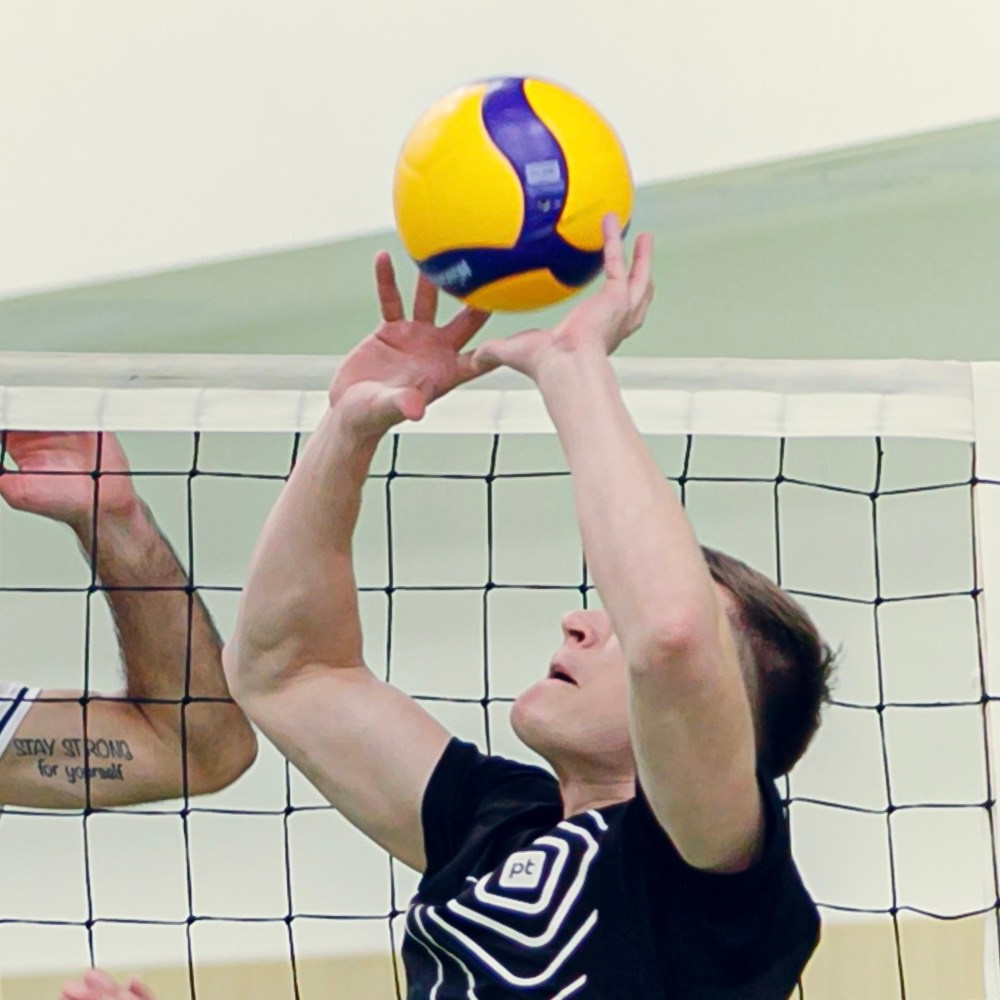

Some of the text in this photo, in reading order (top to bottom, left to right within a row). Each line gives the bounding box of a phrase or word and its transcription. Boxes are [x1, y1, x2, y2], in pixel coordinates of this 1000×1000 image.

[13, 738, 55, 757] STAY
[37, 758, 58, 777] for
[508, 858, 535, 879] pt
